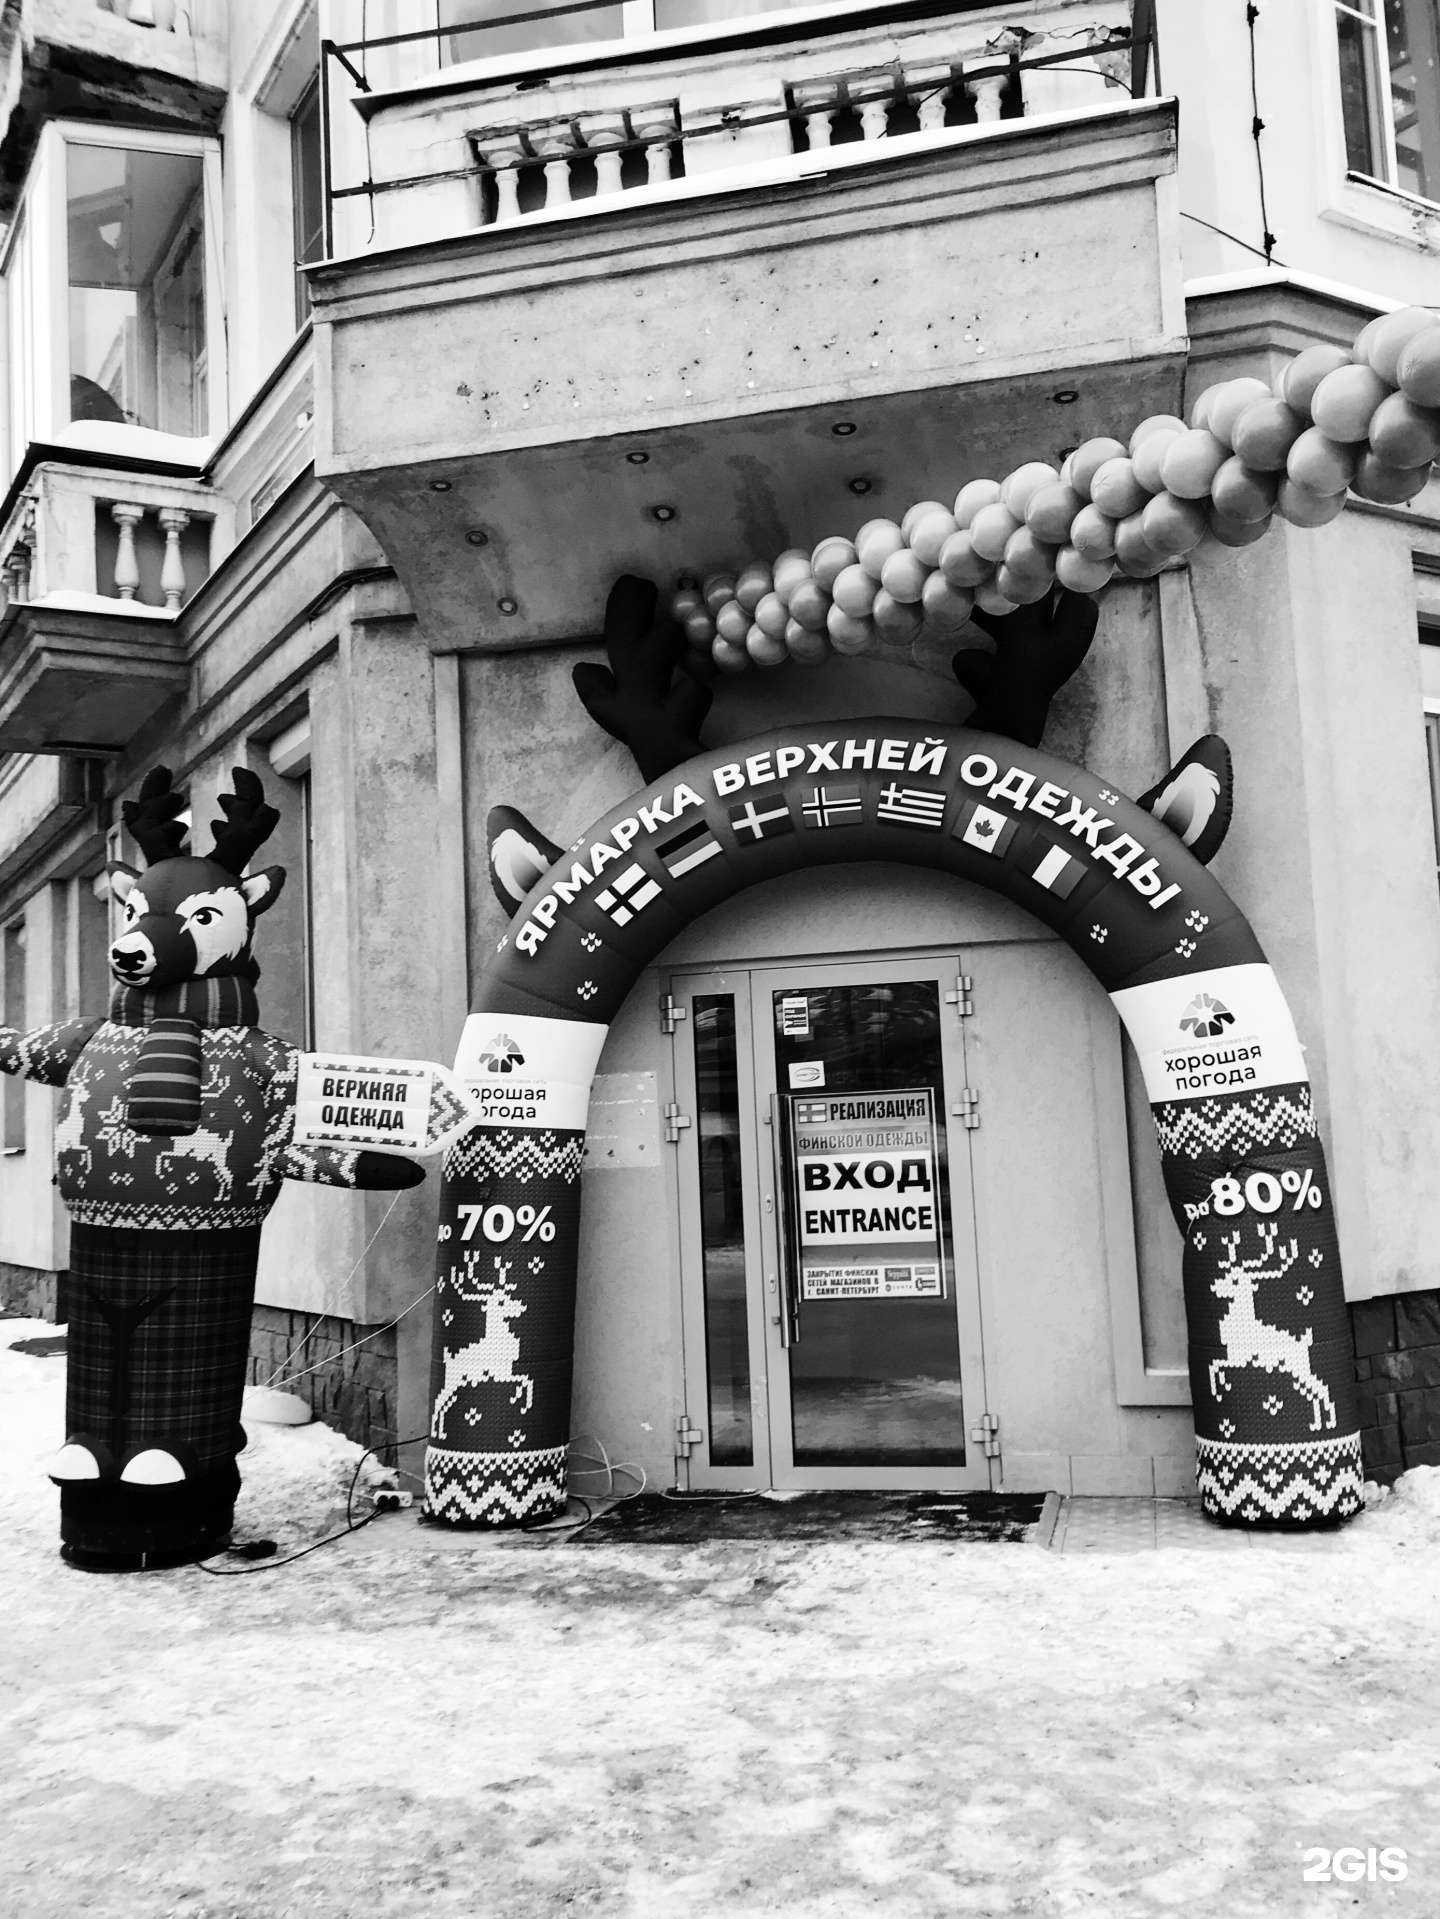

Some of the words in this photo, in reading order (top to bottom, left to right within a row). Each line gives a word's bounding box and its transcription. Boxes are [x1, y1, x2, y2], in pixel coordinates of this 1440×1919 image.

[514, 782, 707, 958] ЯРМАРКА
[712, 737, 948, 797] ВЕРХНЕЙ
[960, 753, 1183, 910] ОДЕЖДЫ
[1165, 1045, 1262, 1072] хорошая
[322, 1077, 408, 1103] ВЕРХНЯЯ
[1176, 1066, 1256, 1090] погода
[469, 1088, 546, 1103] орошая
[321, 1104, 405, 1131] ОДЕЖДА
[481, 1106, 537, 1120] огода
[830, 1098, 926, 1121] РЕАЛИЗАЦИЯ
[866, 1131, 928, 1148] ОДЕЖДЫ
[804, 1158, 931, 1194] ВХОД
[1183, 1202, 1210, 1220] до
[1210, 1168, 1322, 1216] 80%
[457, 1204, 556, 1242] 70%
[805, 1206, 933, 1234] ENTRANCE
